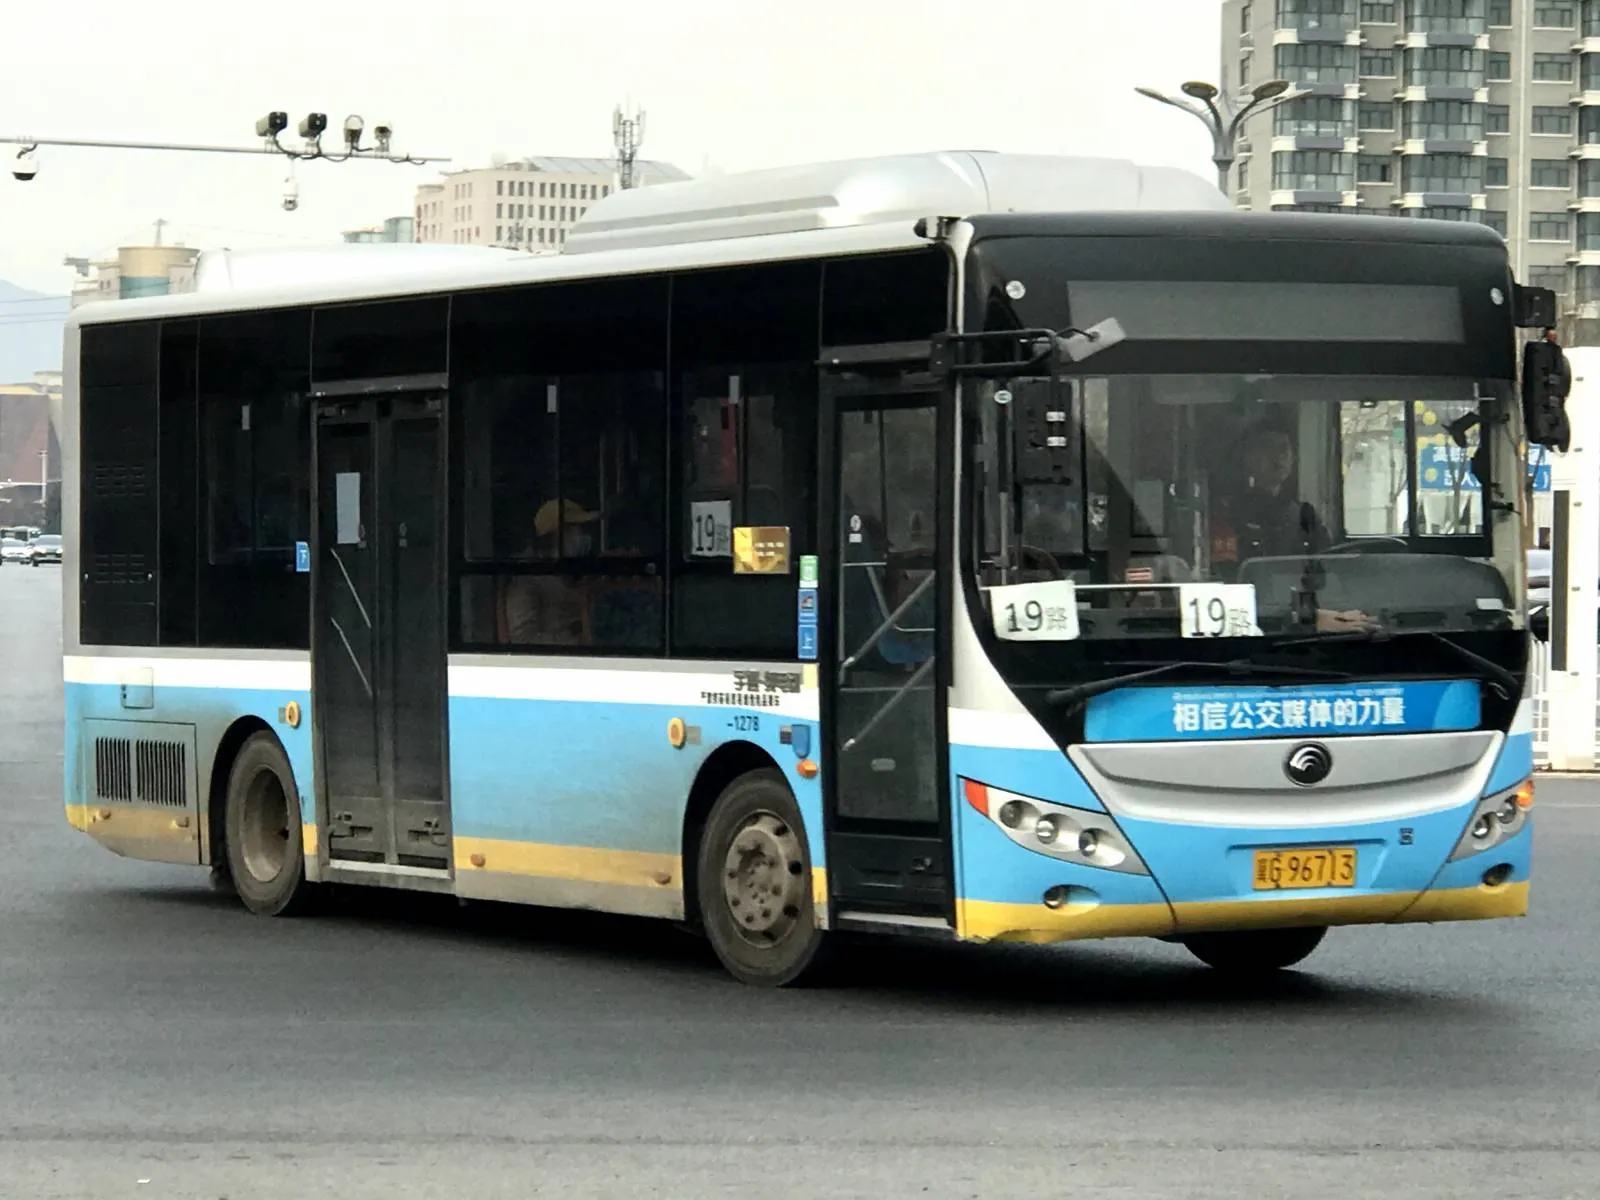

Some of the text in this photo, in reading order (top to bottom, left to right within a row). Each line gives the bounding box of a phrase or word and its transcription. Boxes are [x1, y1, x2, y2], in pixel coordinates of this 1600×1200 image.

[1173, 697, 1406, 732] 相信公交媒体的力量
